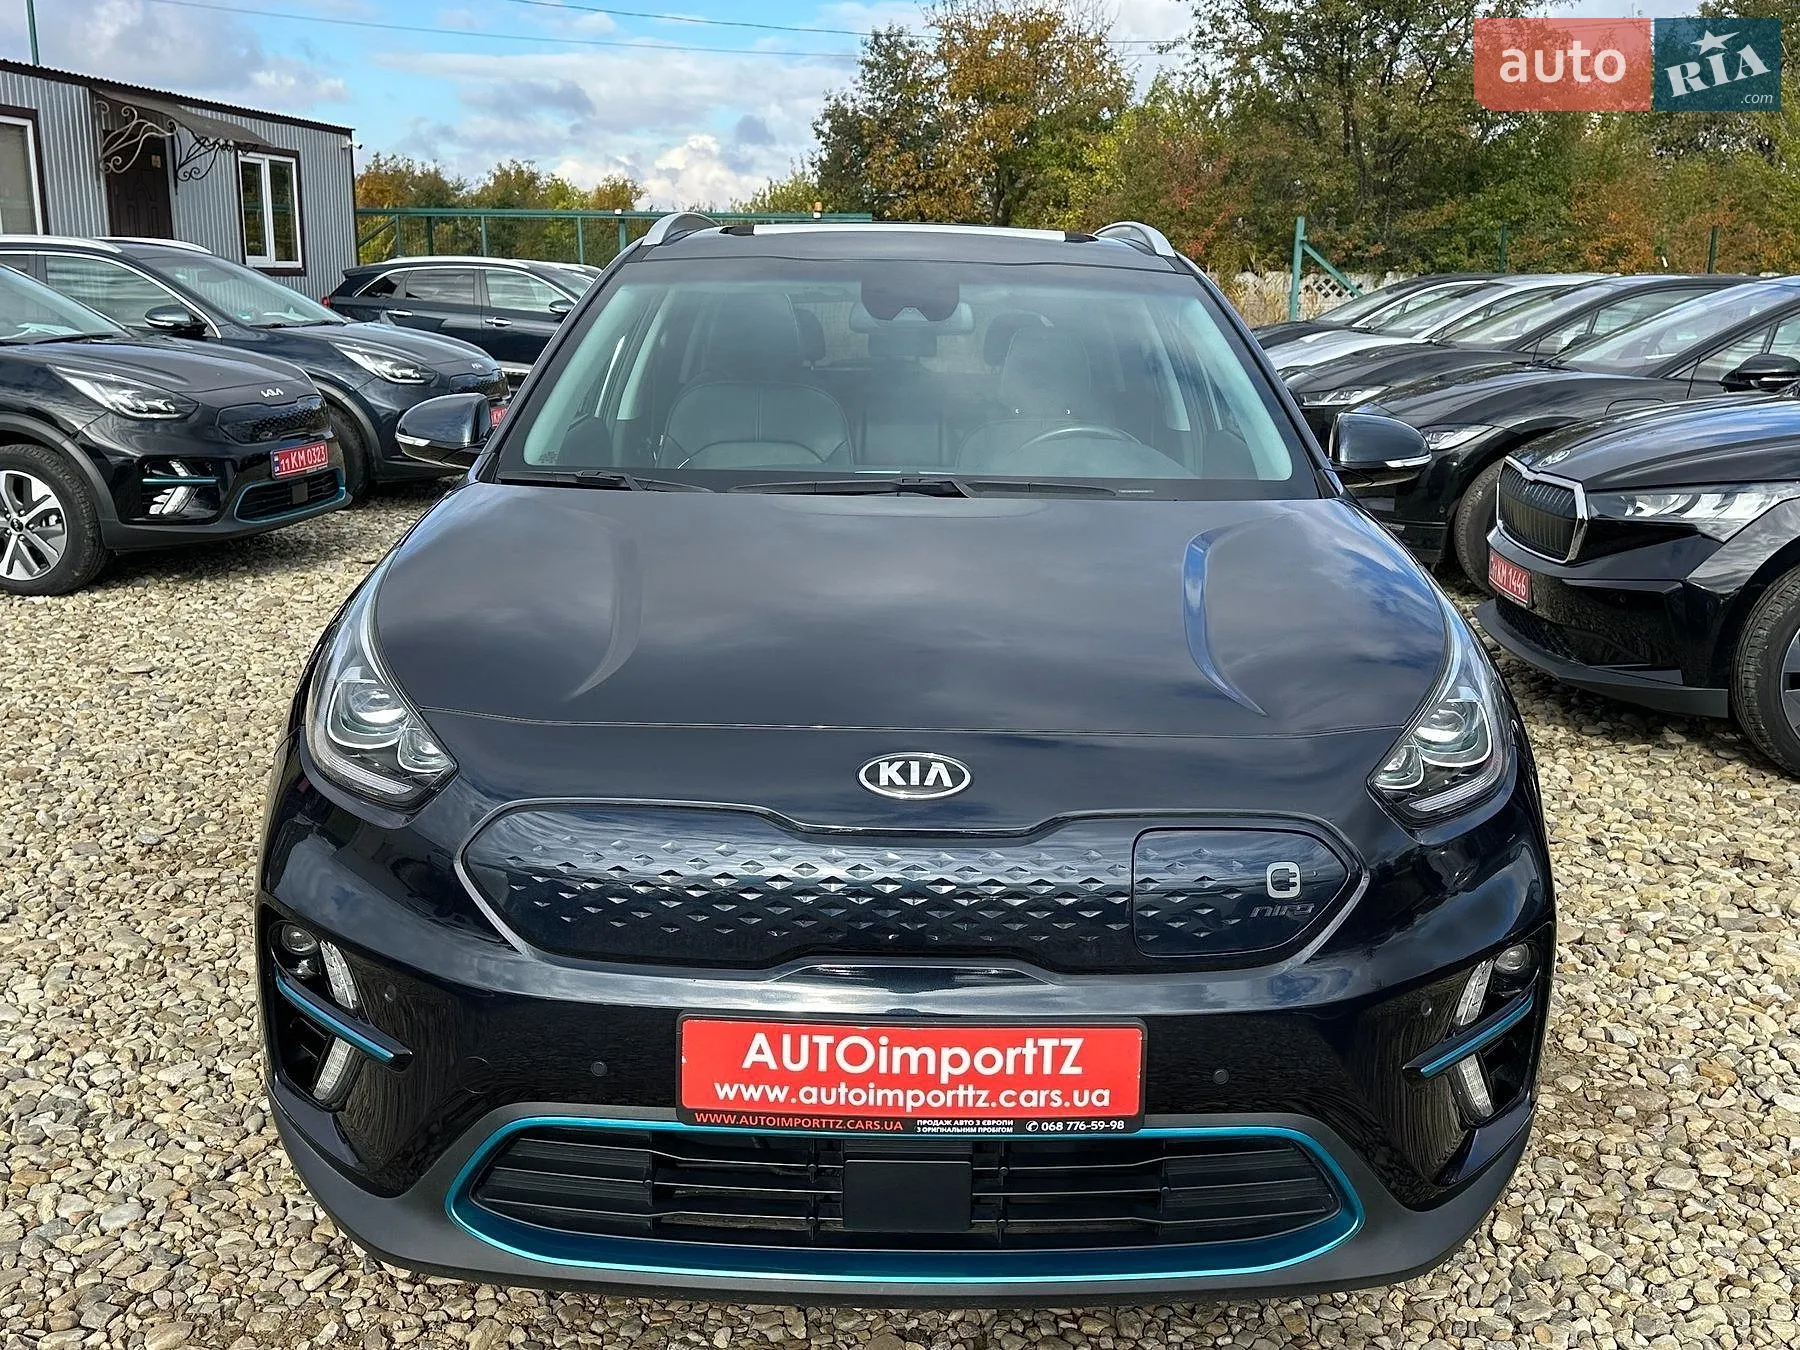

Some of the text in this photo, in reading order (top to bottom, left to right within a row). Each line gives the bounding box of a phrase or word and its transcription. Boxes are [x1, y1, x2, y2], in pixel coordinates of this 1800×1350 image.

[878, 760, 954, 788] KIA
[741, 1031, 1085, 1085] AUTOimportTZ
[713, 1081, 1111, 1113] www.autoimporttz.cars.ua
[694, 1112, 904, 1131] WWW.AUTOIMPORTTZ.CARS.UA
[916, 1119, 953, 1127] ПРОДАЖ
[1041, 1120, 1125, 1131] 068 776-59-98
